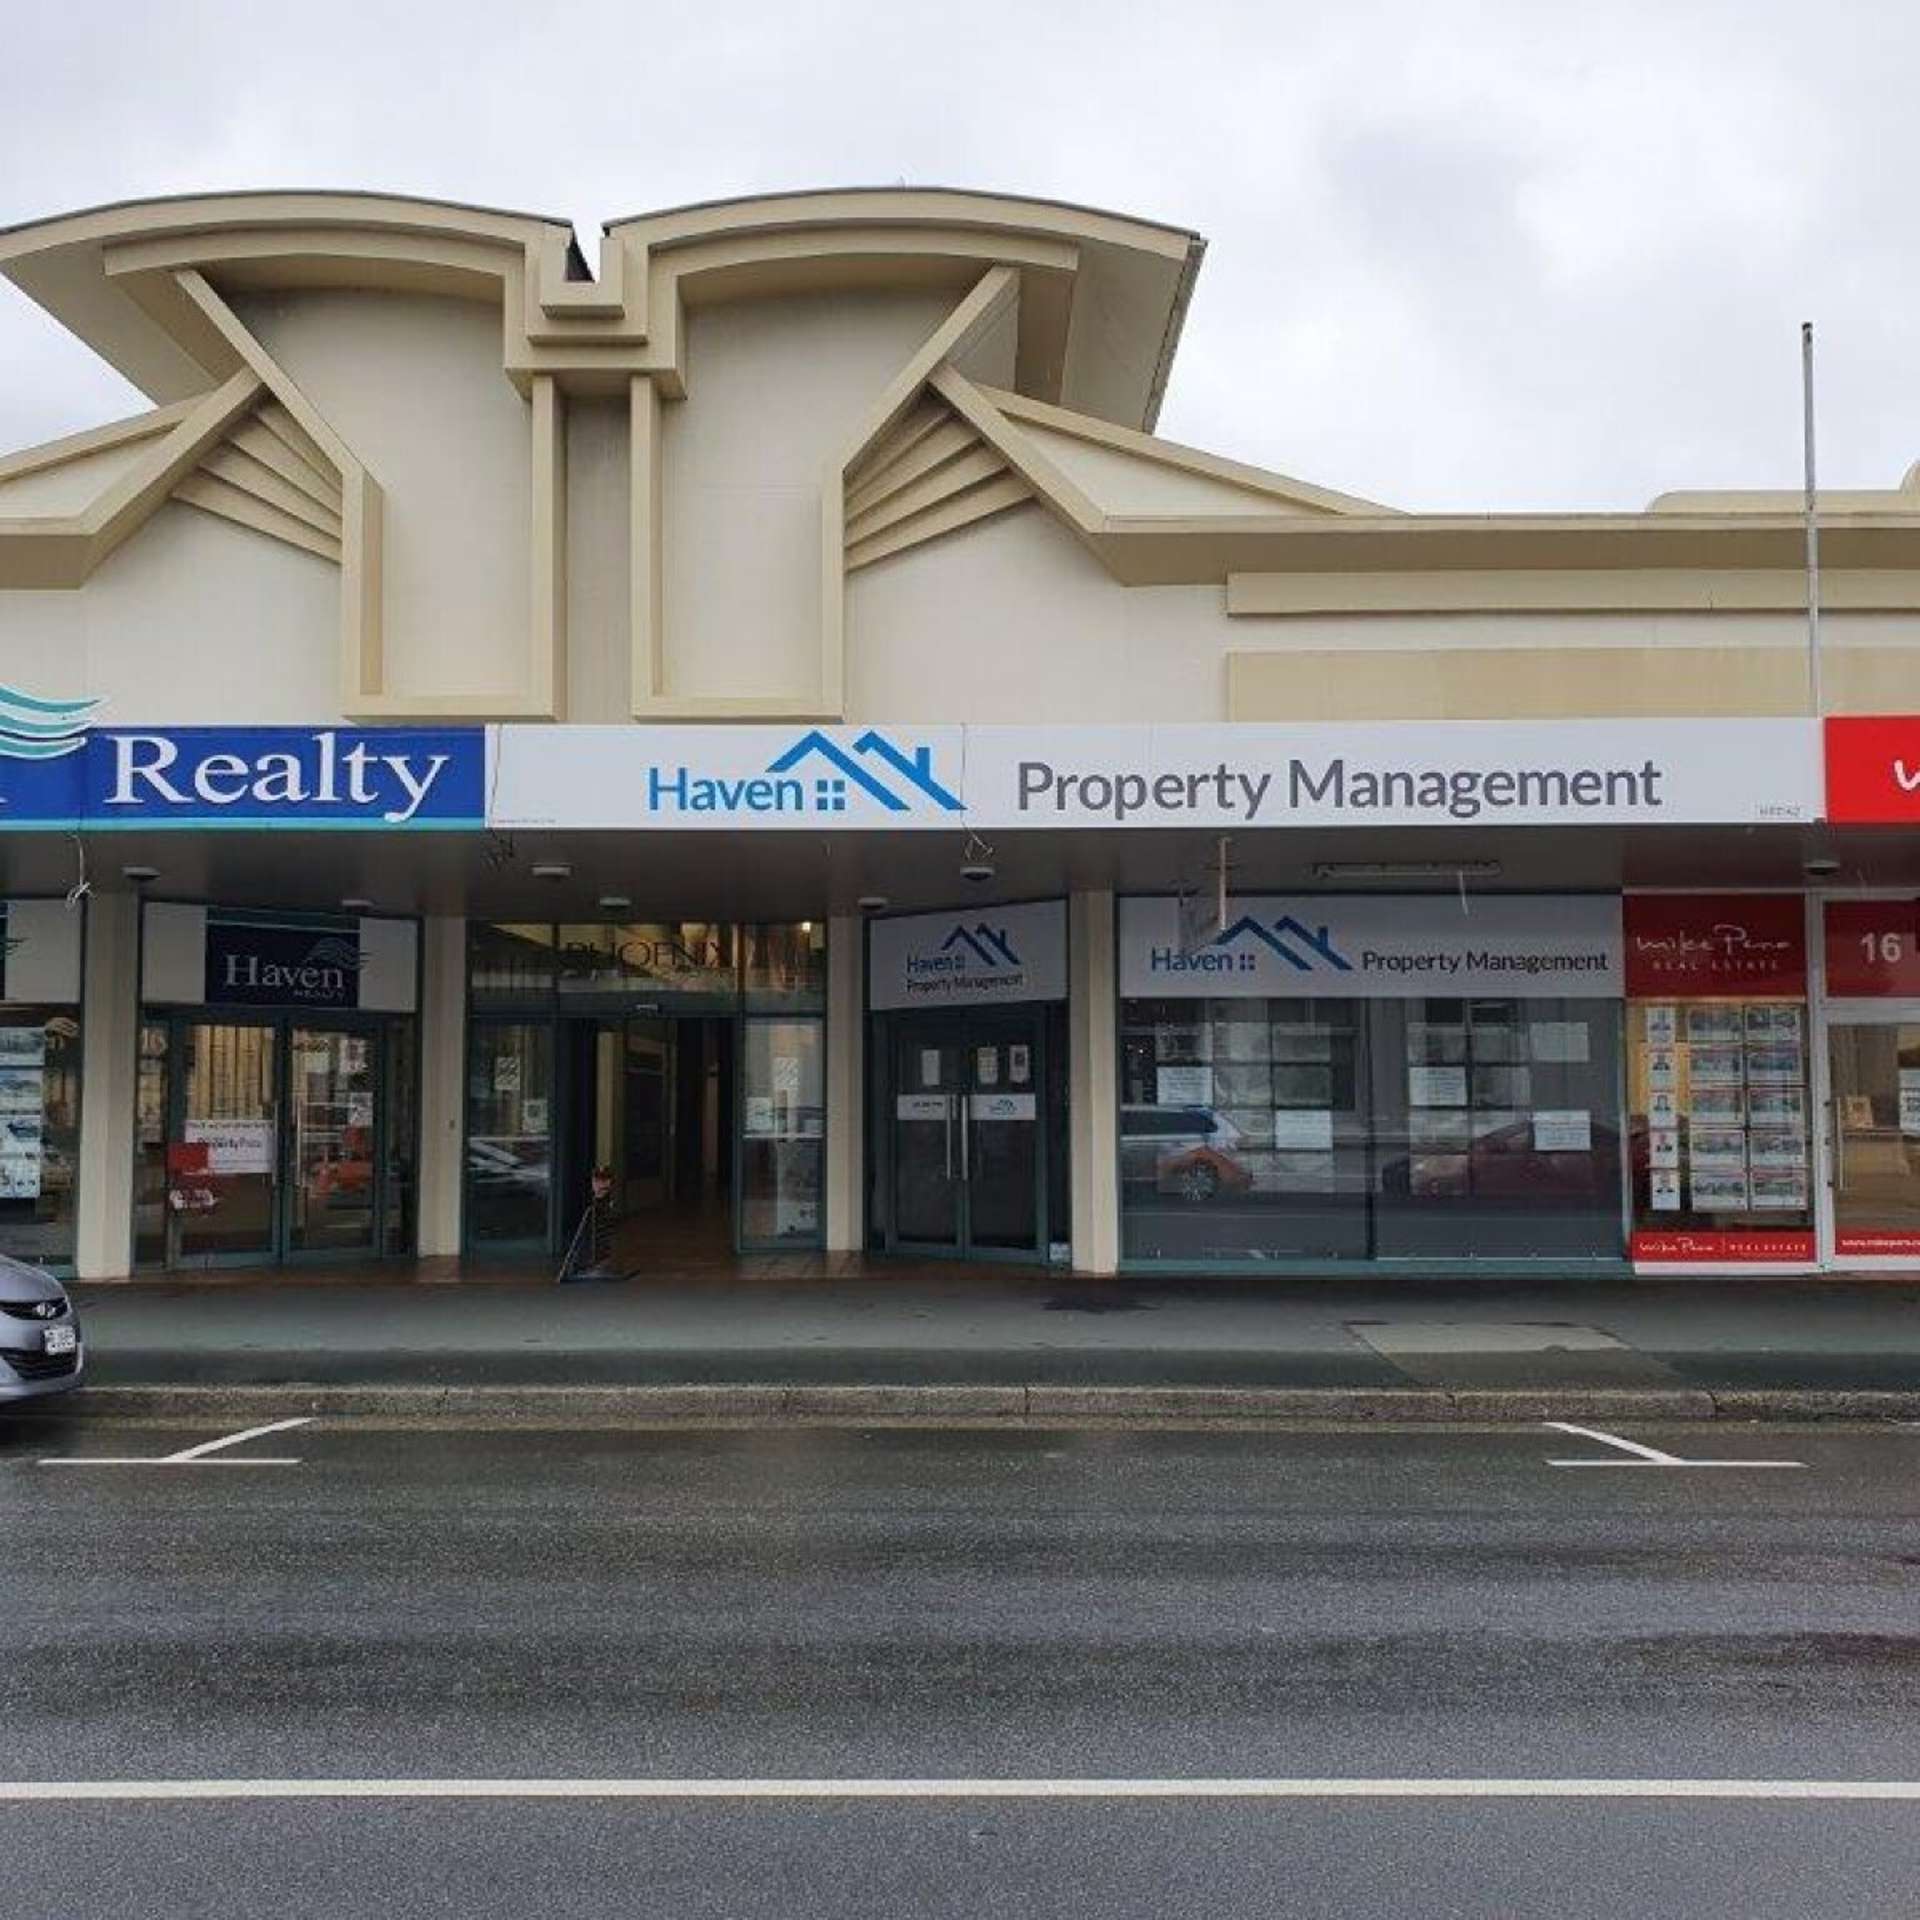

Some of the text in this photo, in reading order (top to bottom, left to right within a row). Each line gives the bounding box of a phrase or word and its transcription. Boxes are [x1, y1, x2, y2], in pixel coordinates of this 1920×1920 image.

[103, 731, 450, 823] Realty
[648, 766, 804, 812] Haven
[1017, 758, 1663, 820] Property Management
[905, 953, 953, 974] Haven
[1151, 946, 1234, 971] Haven
[1361, 950, 1609, 974] Property Management
[1861, 932, 1902, 963] 16
[226, 953, 344, 989] Haven
